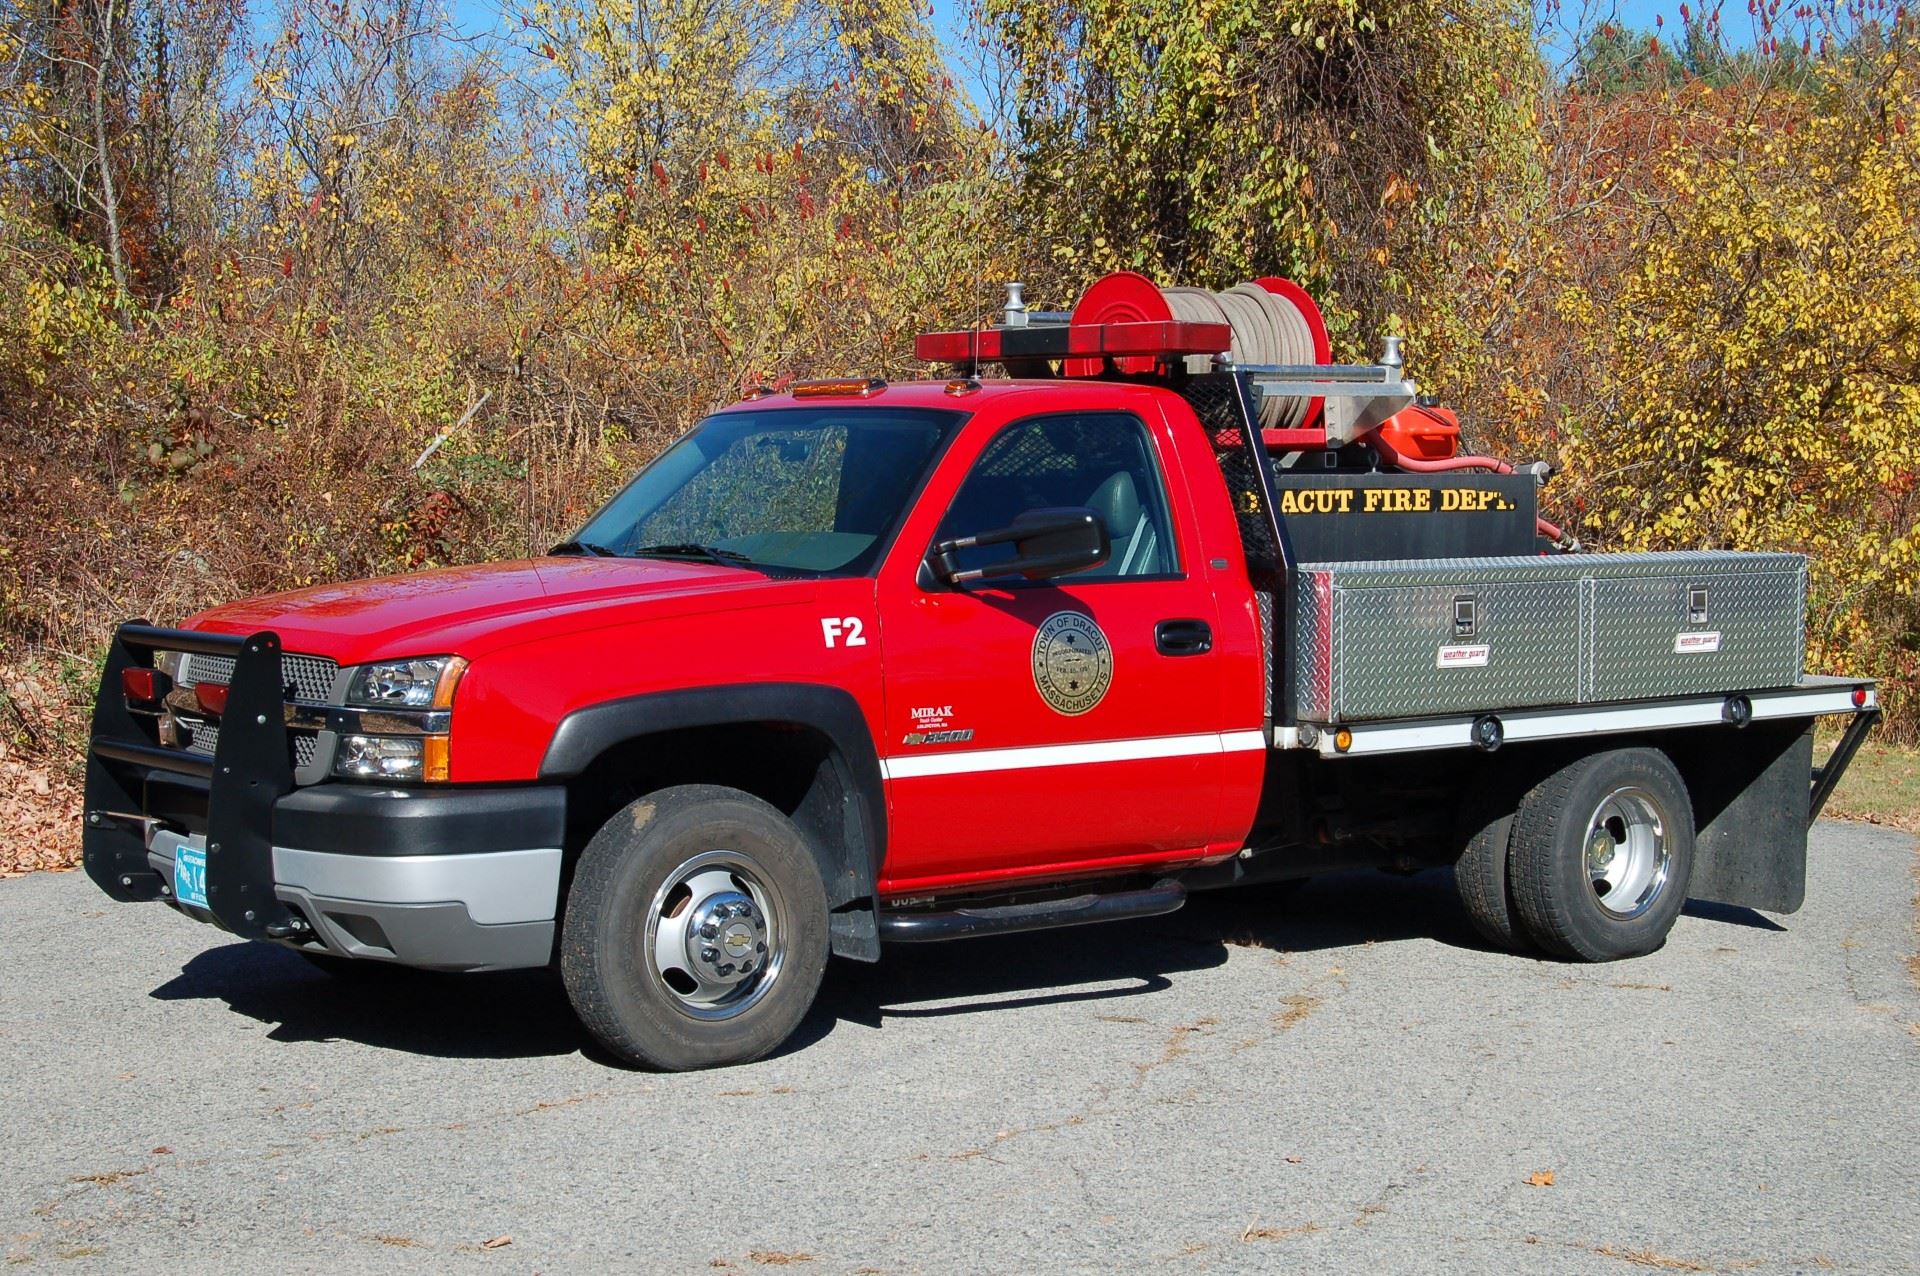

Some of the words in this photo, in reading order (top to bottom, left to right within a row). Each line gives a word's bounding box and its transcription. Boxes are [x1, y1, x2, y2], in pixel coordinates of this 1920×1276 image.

[1363, 489, 1430, 512] FIRE
[820, 616, 867, 649] F2
[1037, 624, 1056, 656] TOWN
[1056, 617, 1069, 628] OF
[1072, 617, 1106, 652] DRACUT
[1443, 650, 1468, 658] weather
[1469, 649, 1486, 659] guard
[1039, 671, 1108, 710] MASSACHUSETTS
[911, 705, 954, 719] MIRAK
[925, 729, 974, 744] 3500
